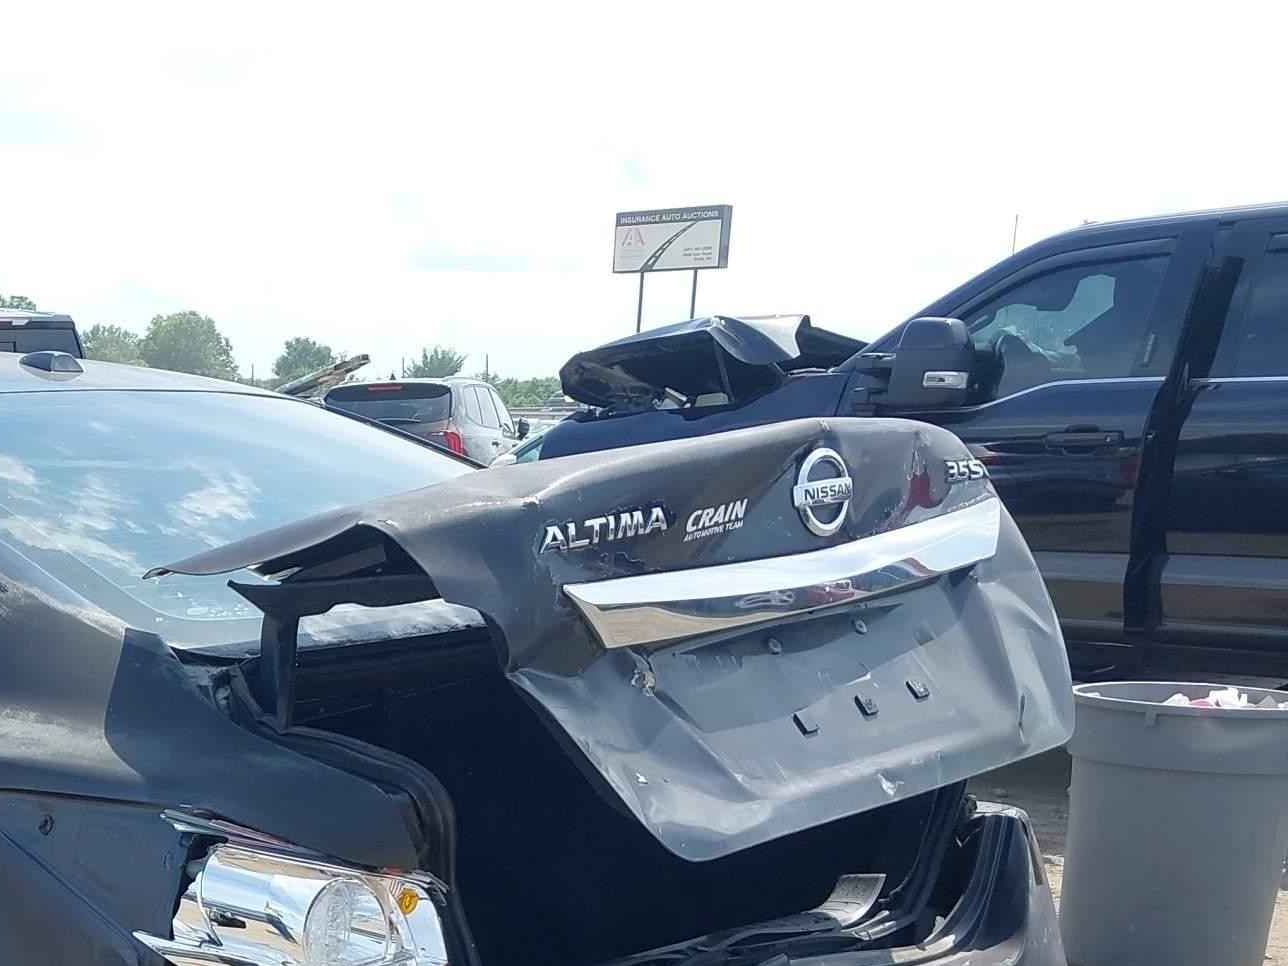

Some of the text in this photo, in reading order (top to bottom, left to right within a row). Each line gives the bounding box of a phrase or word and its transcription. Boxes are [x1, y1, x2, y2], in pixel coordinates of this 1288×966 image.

[620, 210, 719, 224] INSURANCE AUTO AUCTIONS
[804, 482, 851, 501] NISSAN
[686, 498, 748, 533] CRAIN
[539, 506, 668, 554] ALTIMA
[683, 519, 744, 543] AUTOMOTIVE TEAM
